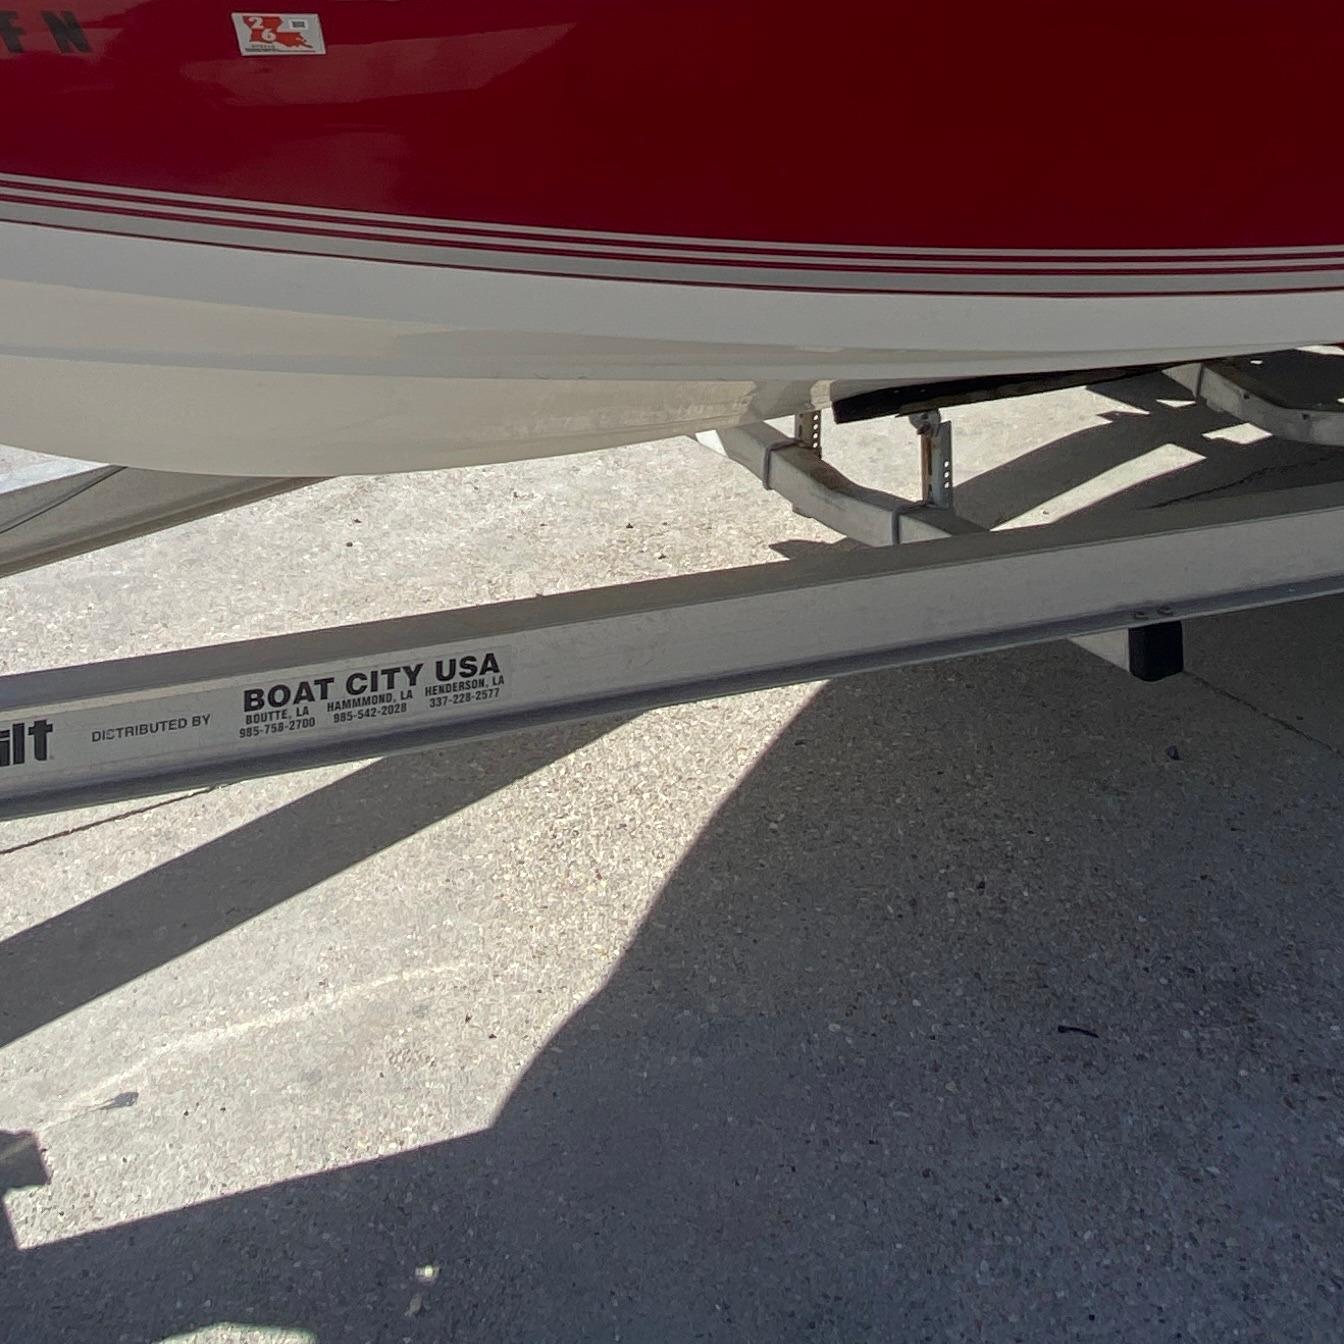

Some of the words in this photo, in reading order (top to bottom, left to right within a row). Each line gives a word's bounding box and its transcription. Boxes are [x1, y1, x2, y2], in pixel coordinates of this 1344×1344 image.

[244, 677, 335, 712] BOAT
[346, 663, 424, 695] CITY
[435, 653, 500, 682] USA
[492, 675, 505, 686] LA
[400, 690, 413, 700] LA
[429, 687, 500, 708] 337-228-2577
[296, 706, 309, 717] LA
[333, 702, 407, 723] 985-542-2028
[91, 717, 188, 743] DISTRIBUTED
[192, 714, 211, 727] BY
[239, 717, 316, 738] 985-758-2700
